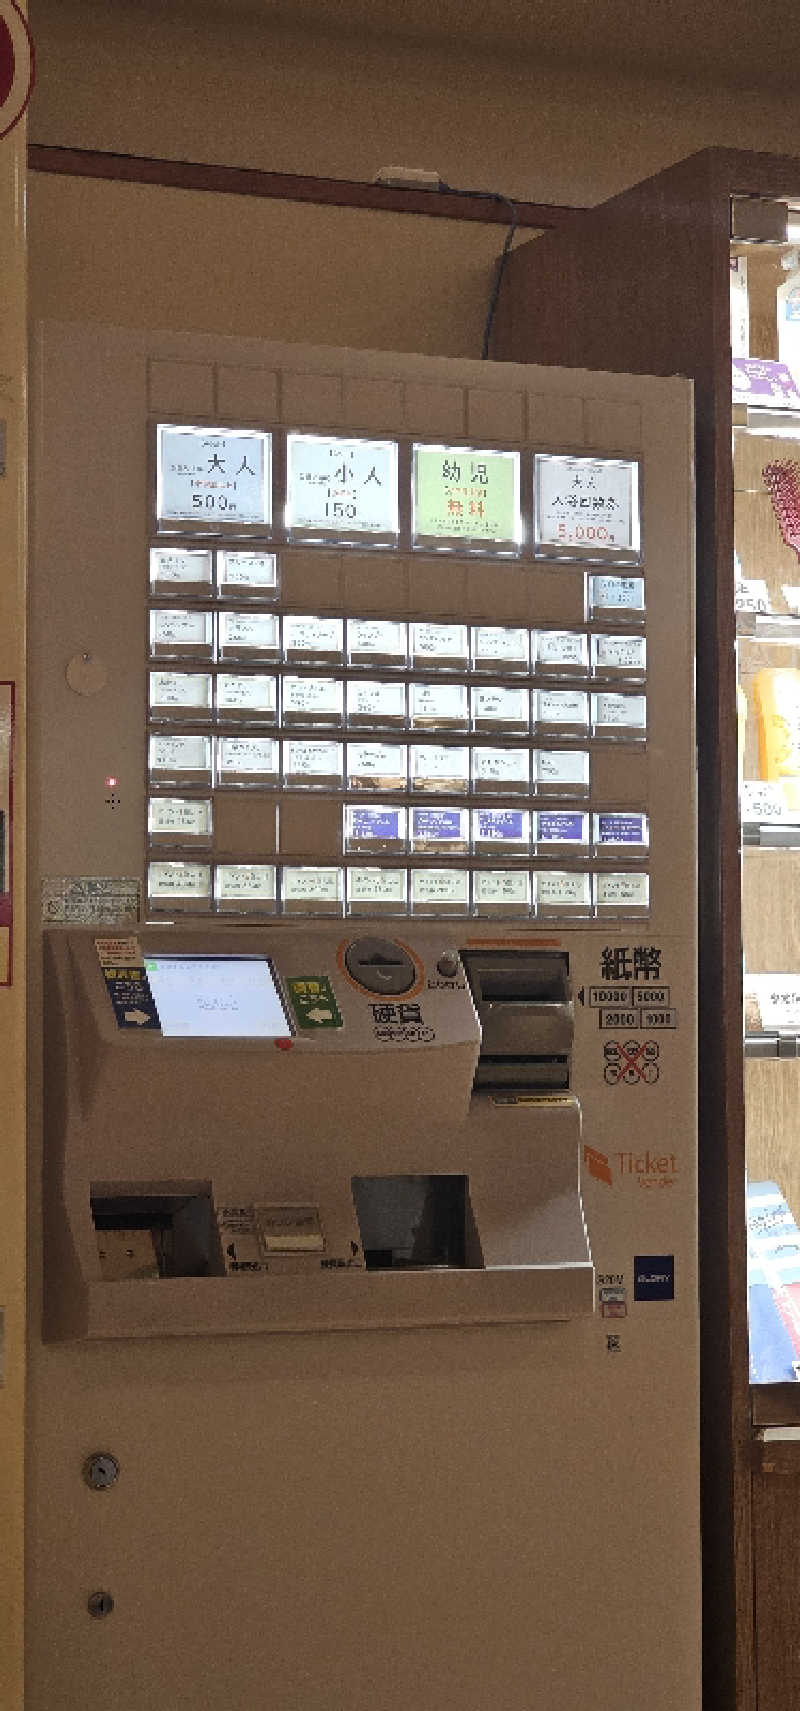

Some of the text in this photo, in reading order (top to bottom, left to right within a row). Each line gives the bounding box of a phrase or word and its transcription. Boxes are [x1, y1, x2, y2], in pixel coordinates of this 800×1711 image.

[441, 459, 488, 485] 幼児
[447, 498, 485, 518] 無料
[600, 945, 662, 981] 紙幣
[616, 1151, 678, 1175] Ticket
